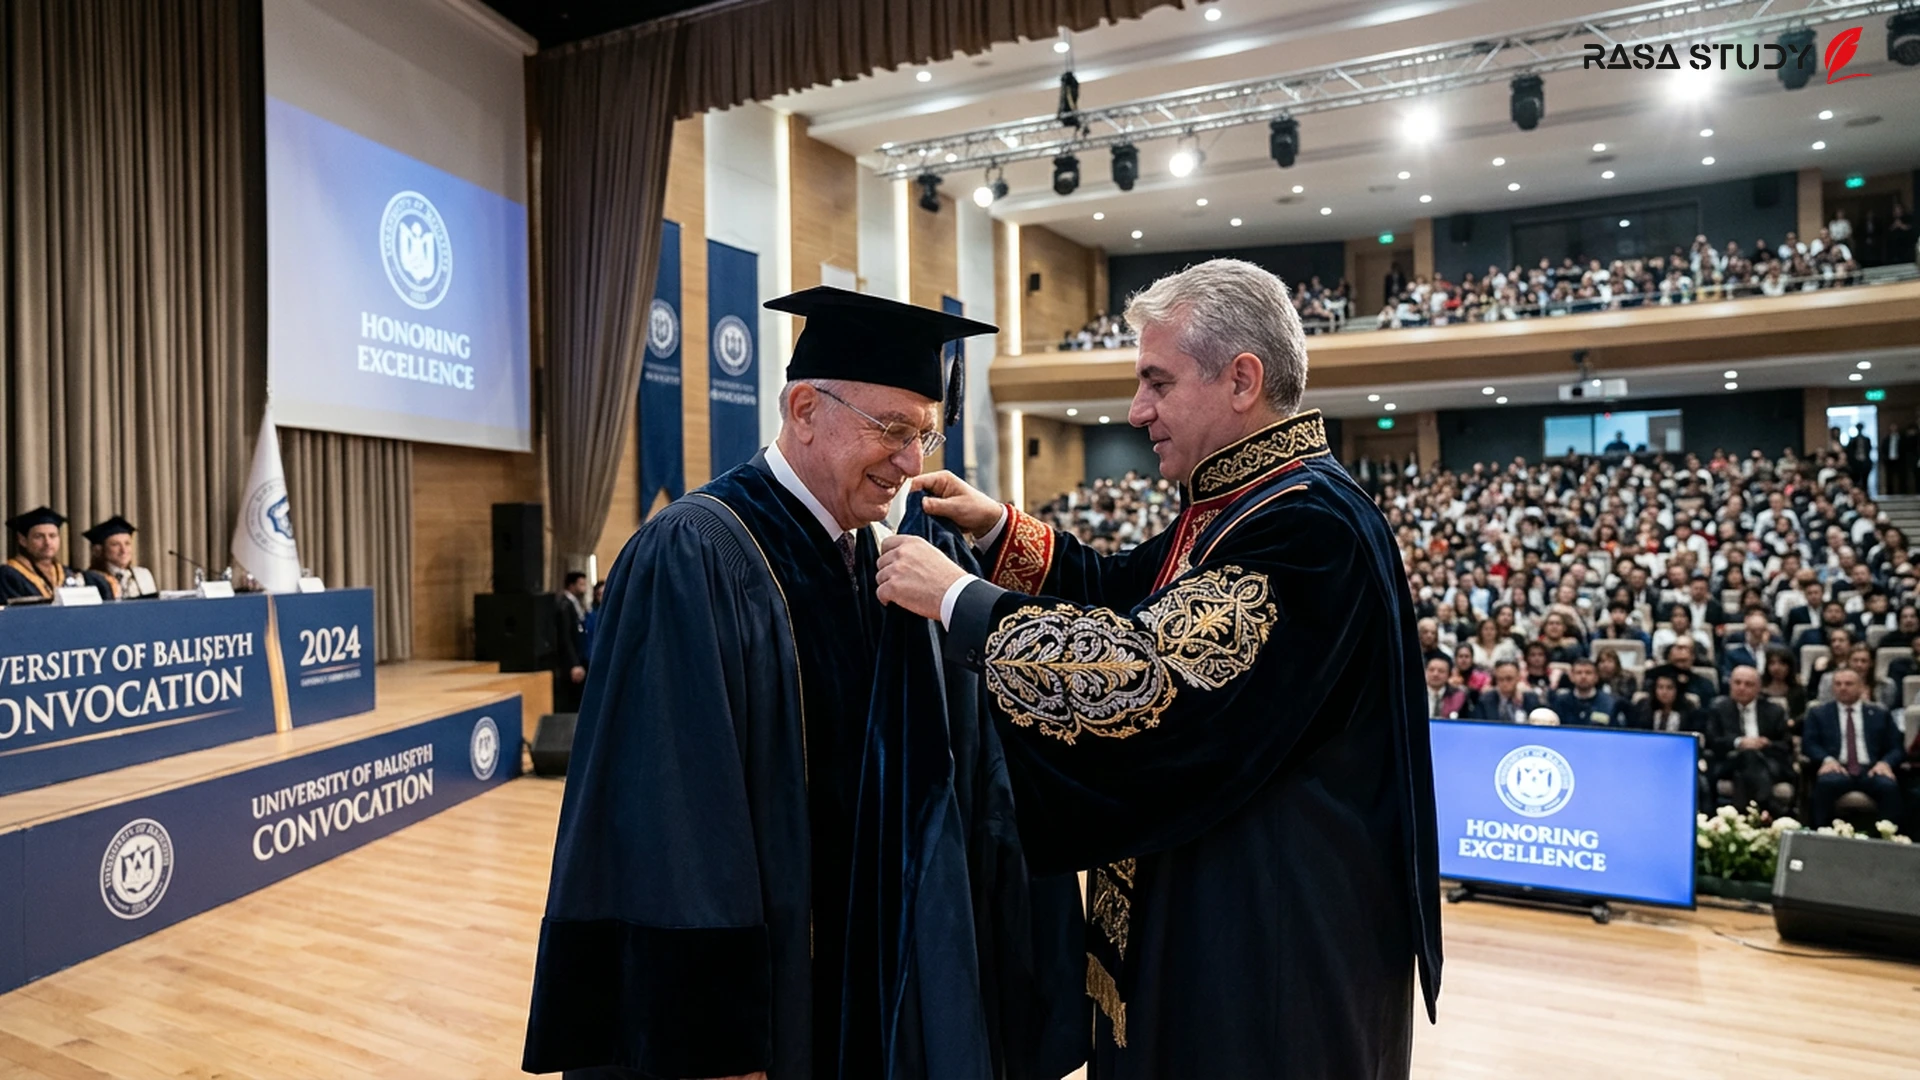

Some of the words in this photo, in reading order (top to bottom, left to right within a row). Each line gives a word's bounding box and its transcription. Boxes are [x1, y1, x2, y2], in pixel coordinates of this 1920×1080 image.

[360, 311, 471, 360] HONORING
[357, 344, 475, 391] EXCELLENCE
[111, 643, 147, 672] OF
[152, 632, 254, 668] BALIŞEYH
[299, 624, 362, 667] 2024
[0, 665, 244, 740] ONVOCATION
[252, 769, 350, 820] UNIVERSITY
[351, 761, 372, 787] OF
[252, 767, 434, 861] CONVOCATION
[1458, 837, 1607, 872] EXCELLENCE
[1466, 818, 1600, 850] HONORING
